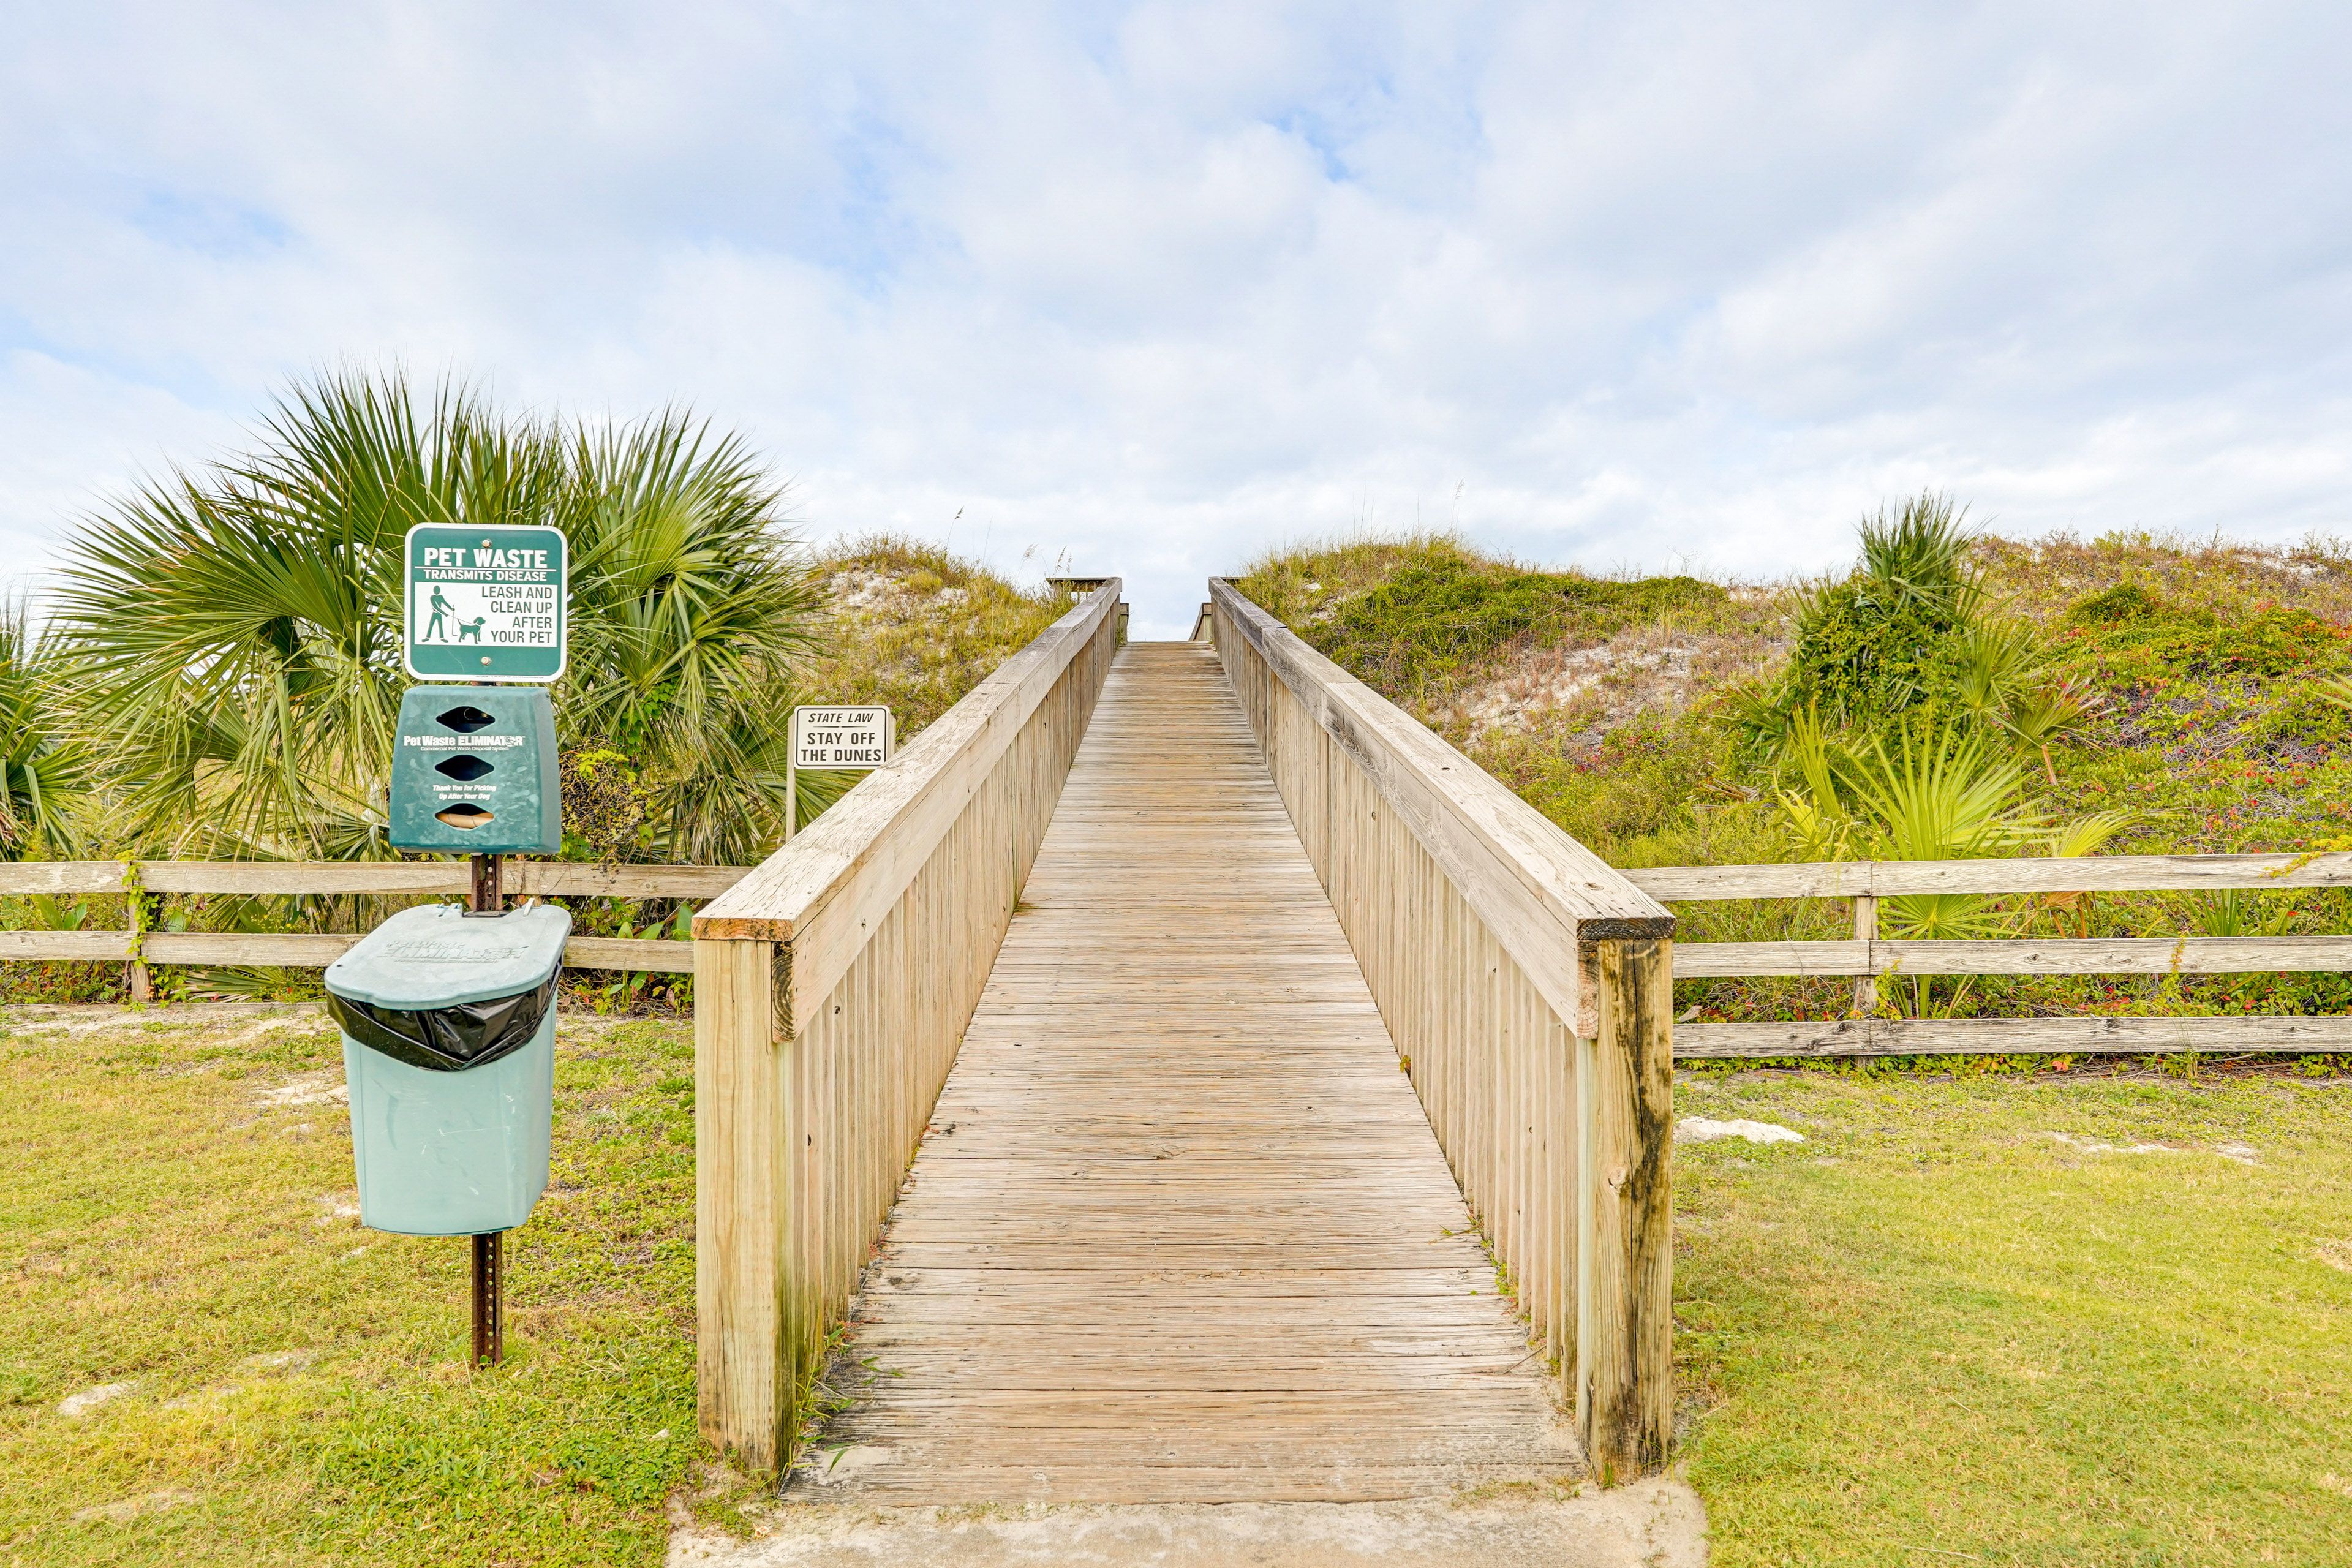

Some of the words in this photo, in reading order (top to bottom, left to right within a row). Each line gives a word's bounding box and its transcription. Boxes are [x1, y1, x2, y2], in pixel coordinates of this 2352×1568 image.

[424, 547, 466, 567] PET
[473, 548, 548, 568] WASTE
[423, 568, 493, 581] TRANSMITS
[496, 570, 547, 582] DISEASE
[481, 586, 522, 598] LEASH
[526, 587, 552, 599] AND
[491, 601, 532, 613] CLEAN
[536, 601, 552, 614] UP
[512, 616, 552, 628] AFTER
[491, 630, 525, 643] YOUR
[529, 631, 552, 643] PET
[809, 713, 843, 723] STATE
[848, 713, 874, 723] LAW
[404, 736, 421, 746] Pet
[422, 736, 456, 747] Waste
[807, 733, 843, 745] STAY
[851, 733, 875, 745] OFF
[801, 749, 827, 761] THE
[834, 748, 881, 761] DUNES
